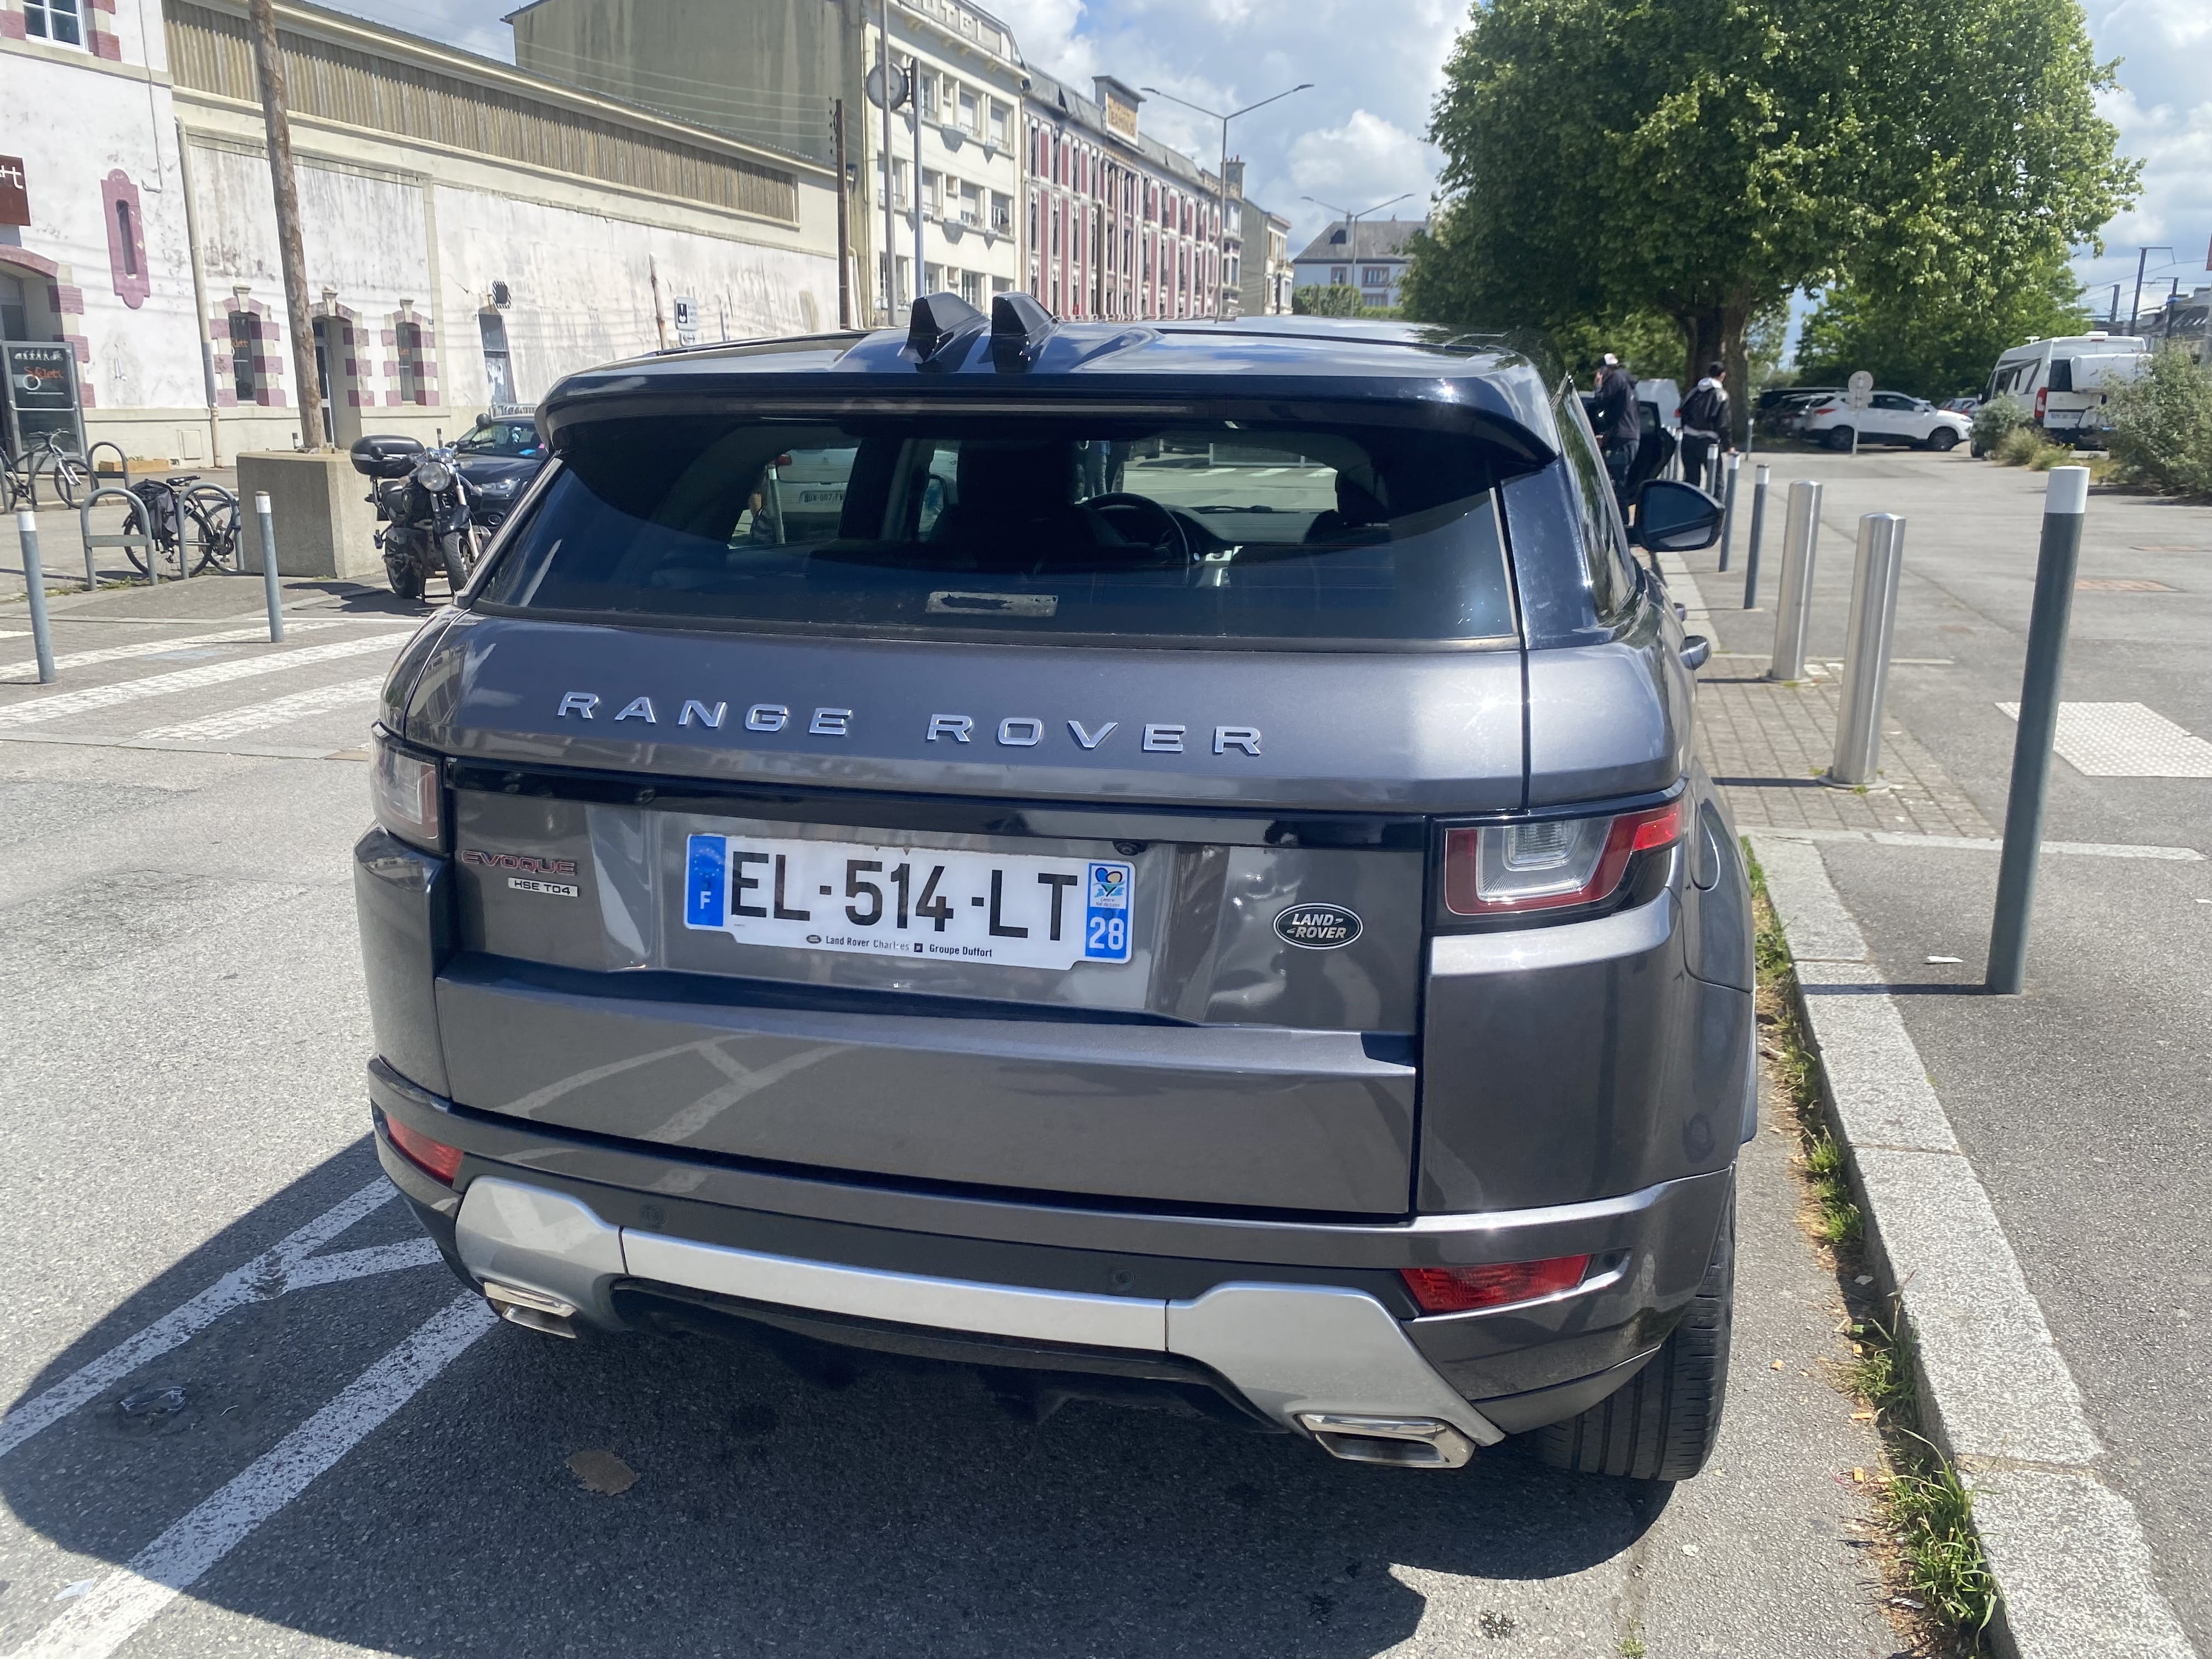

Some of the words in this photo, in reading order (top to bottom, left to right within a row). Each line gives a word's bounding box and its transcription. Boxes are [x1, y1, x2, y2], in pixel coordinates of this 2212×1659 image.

[557, 691, 853, 736] RANGE
[926, 714, 1262, 755] ROVER
[461, 850, 577, 877] EVOQUE
[515, 880, 540, 891] HSE
[543, 884, 571, 895] TD4
[700, 890, 712, 910] F
[731, 851, 1079, 941] EL-514-LT
[826, 935, 844, 945] Land
[847, 937, 870, 947] Rover
[929, 944, 960, 955] Groupe
[962, 947, 992, 957] Duffort
[1089, 916, 1125, 950] 28
